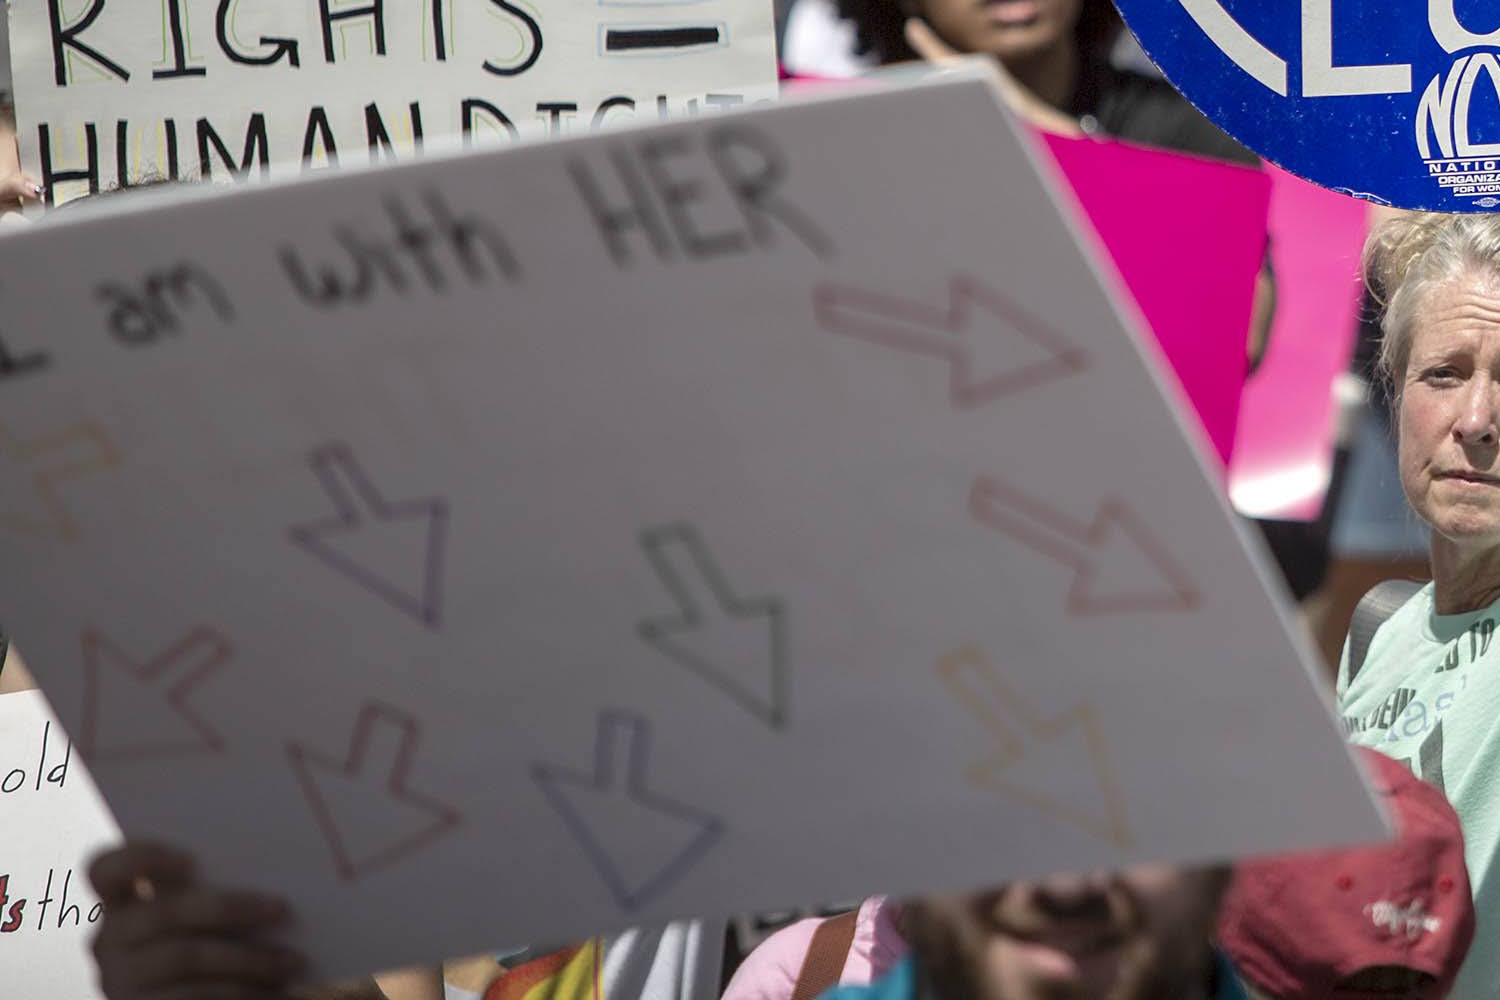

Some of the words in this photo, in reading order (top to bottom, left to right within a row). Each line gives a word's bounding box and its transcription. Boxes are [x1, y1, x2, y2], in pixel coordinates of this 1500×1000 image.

[276, 182, 526, 312] with
[565, 122, 838, 272] HER
[1453, 184, 1476, 194] FOR
